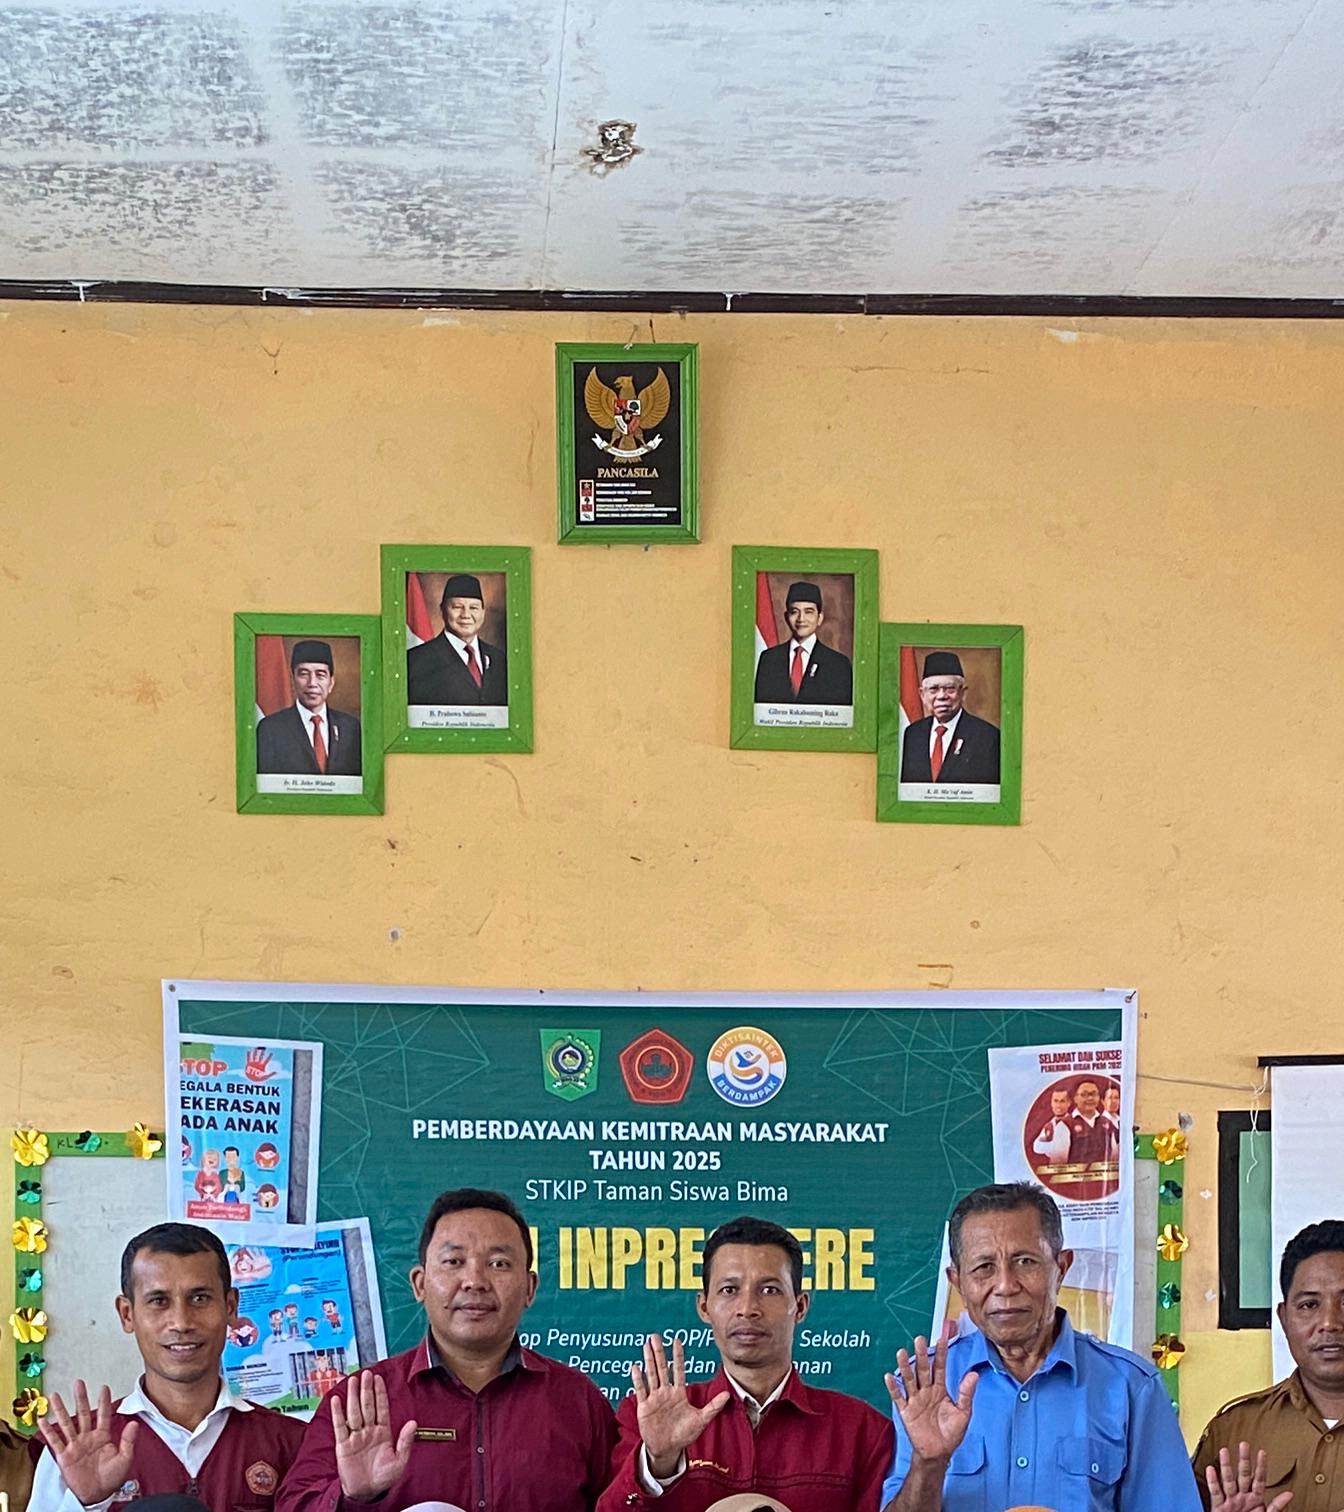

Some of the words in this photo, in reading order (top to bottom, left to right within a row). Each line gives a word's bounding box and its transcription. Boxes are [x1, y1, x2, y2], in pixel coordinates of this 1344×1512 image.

[597, 467, 659, 478] PANCASILA
[714, 1032, 779, 1058] DIKTISAINTEK
[1039, 1052, 1076, 1064] SELAMAT
[1077, 1051, 1094, 1062] DAN
[1095, 1050, 1122, 1061] SUKSE
[180, 1080, 222, 1093] EGALA
[226, 1083, 281, 1097] BENTUK
[717, 1079, 777, 1101] BERDAMPAK
[180, 1096, 281, 1116] EKERASAN
[181, 1115, 219, 1130] ADA
[224, 1117, 279, 1134] ANAK
[412, 1120, 595, 1141] PEMBERDAYAAN
[601, 1121, 734, 1142] KEMITRAAN
[739, 1122, 889, 1143] MASYARAKAT
[588, 1150, 665, 1170] TAHUN
[672, 1151, 722, 1171] 2025
[525, 1180, 587, 1201] STKIP
[593, 1180, 663, 1201] Taman
[669, 1180, 730, 1201] Siswa
[737, 1181, 789, 1202] Bima
[560, 1227, 713, 1290] INPRE
[783, 1228, 875, 1290] ERE
[662, 1328, 715, 1348] SOP/P
[799, 1328, 871, 1348] Sekolah
[684, 1356, 716, 1374] dan
